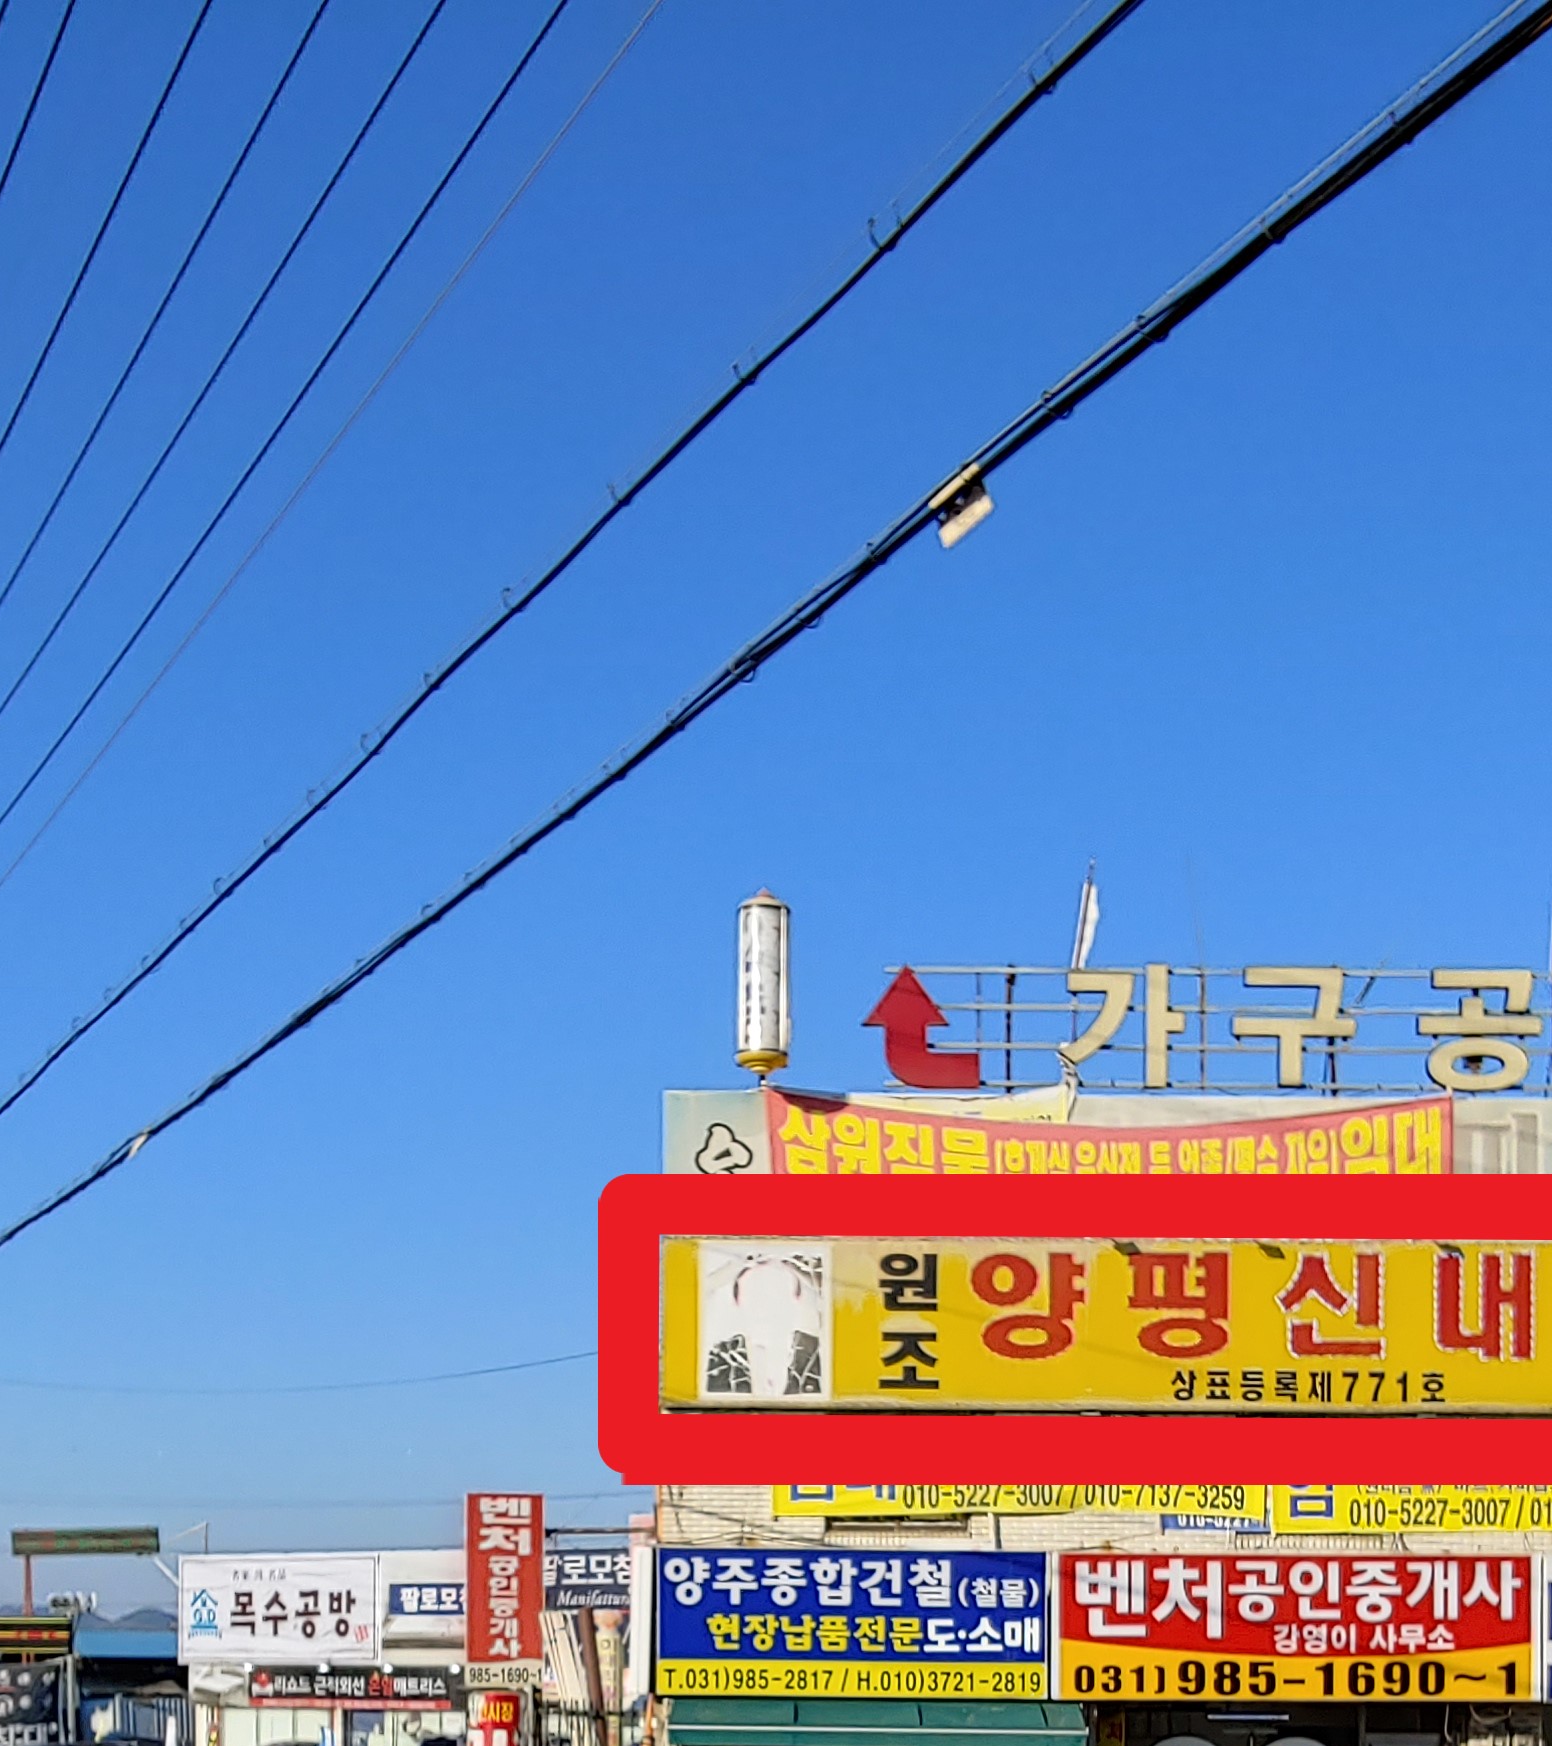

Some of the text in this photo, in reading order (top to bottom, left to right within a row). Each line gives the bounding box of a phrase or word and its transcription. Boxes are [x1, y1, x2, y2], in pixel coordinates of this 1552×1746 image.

[877, 1252, 941, 1392] 원조
[1170, 1368, 1447, 1404] 상표등록제771호
[902, 1483, 1065, 1510] 010-5227-3007
[1084, 1483, 1246, 1510] 010-7137-3259
[1349, 1500, 1508, 1526] 010-5227-3007
[229, 1589, 356, 1638] 목수공방
[400, 1587, 465, 1613] 팔로모
[1273, 1623, 1456, 1654] 강영이 사무소
[469, 1667, 543, 1684] 985-1690~1
[664, 1668, 834, 1691] T.031)985-2817
[857, 1669, 1041, 1694] H.010)3721-2819
